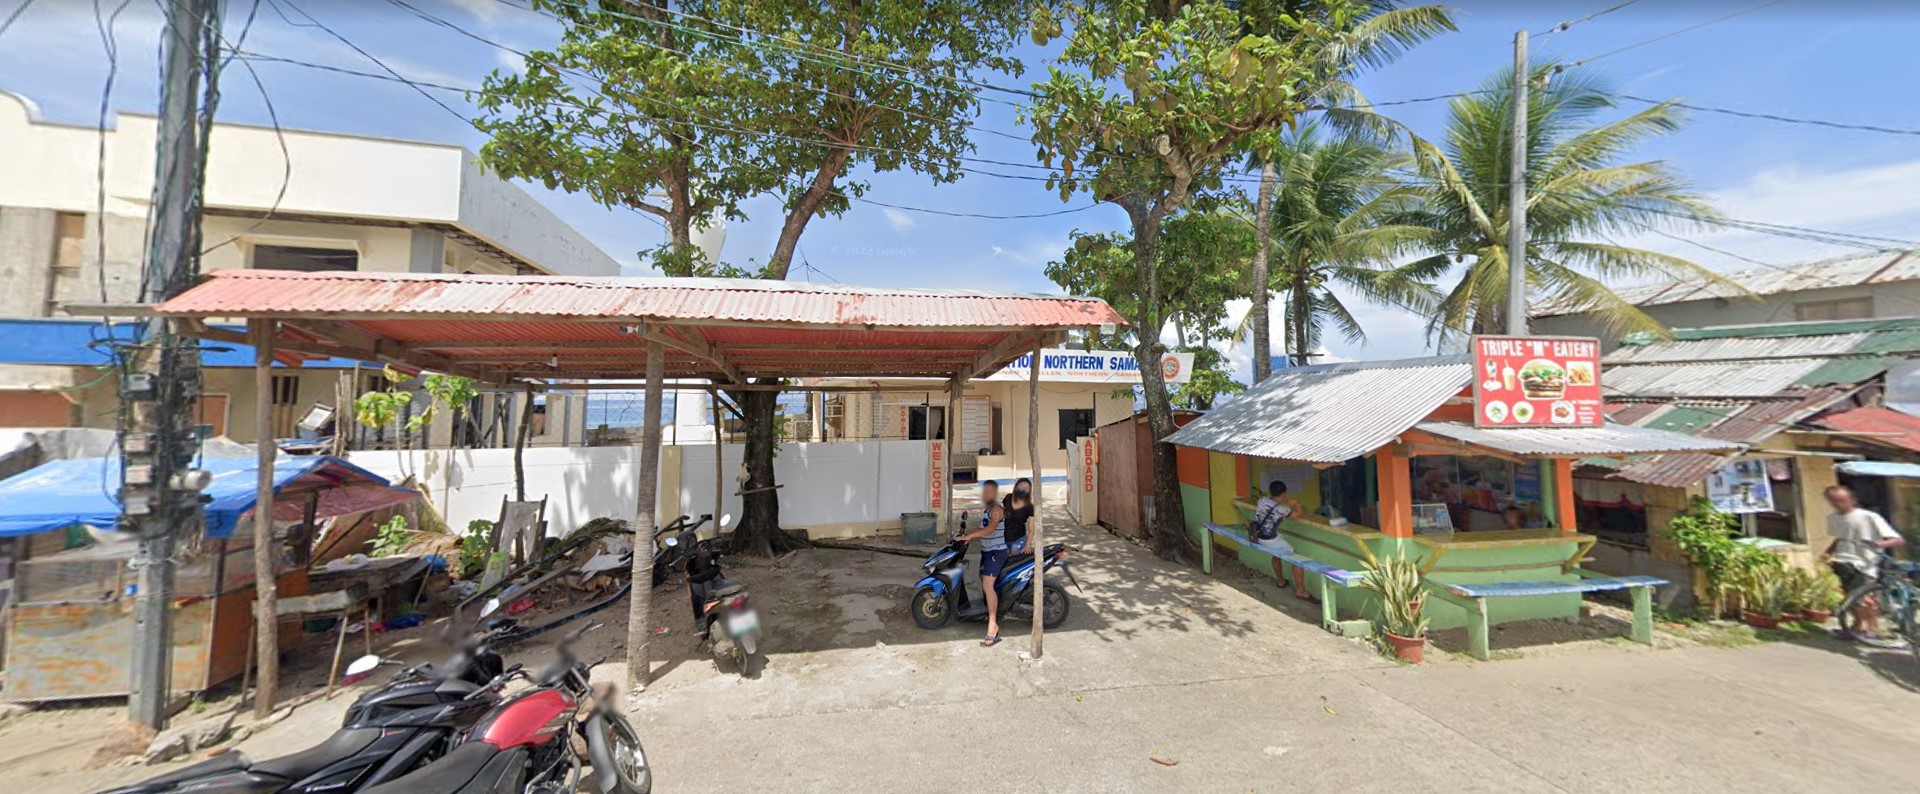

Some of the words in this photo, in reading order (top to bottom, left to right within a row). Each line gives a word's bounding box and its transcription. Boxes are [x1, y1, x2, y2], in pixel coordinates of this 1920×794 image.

[1044, 355, 1104, 369] NORTHERN
[1110, 356, 1140, 370] SAMA
[1481, 340, 1524, 356] TRIPLE
[1553, 341, 1595, 357] EATERY
[931, 442, 942, 508] WELCOME
[1084, 440, 1094, 493] ABOARD
